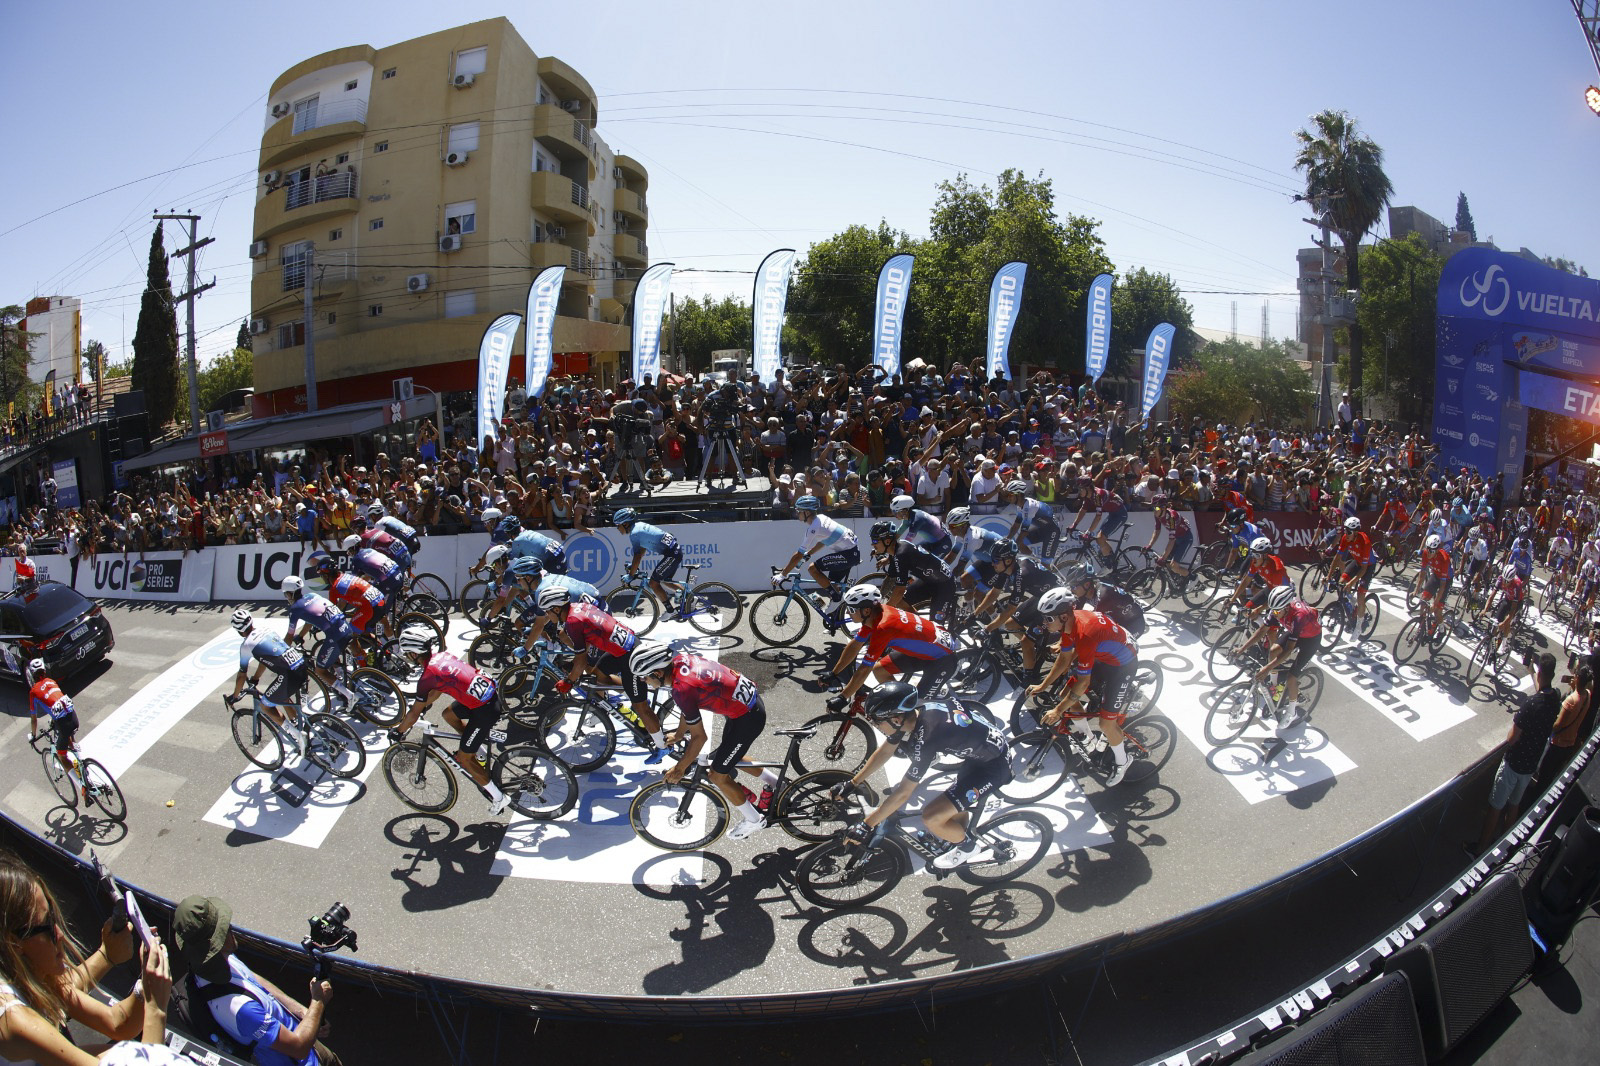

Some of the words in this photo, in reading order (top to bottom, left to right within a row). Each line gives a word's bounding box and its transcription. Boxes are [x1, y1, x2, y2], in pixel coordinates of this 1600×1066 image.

[1517, 290, 1593, 321] VUELTA
[1090, 286, 1106, 370] HIMANO
[680, 543, 720, 555] EDERAL
[1283, 529, 1312, 548] SAN
[148, 564, 164, 576] PRO
[237, 552, 301, 590] UCI
[569, 549, 602, 572] CFI
[94, 559, 127, 590] UCI
[147, 576, 175, 588] SERIES
[612, 626, 629, 647] 225
[469, 677, 490, 701] 226
[735, 678, 756, 705] 224
[1113, 682, 1129, 709] CHILE
[490, 730, 506, 741] 226
[722, 743, 743, 767] ECUADOR
[978, 782, 993, 795] DSM
[985, 801, 1002, 810] 53
[899, 833, 936, 858] SCOTT
